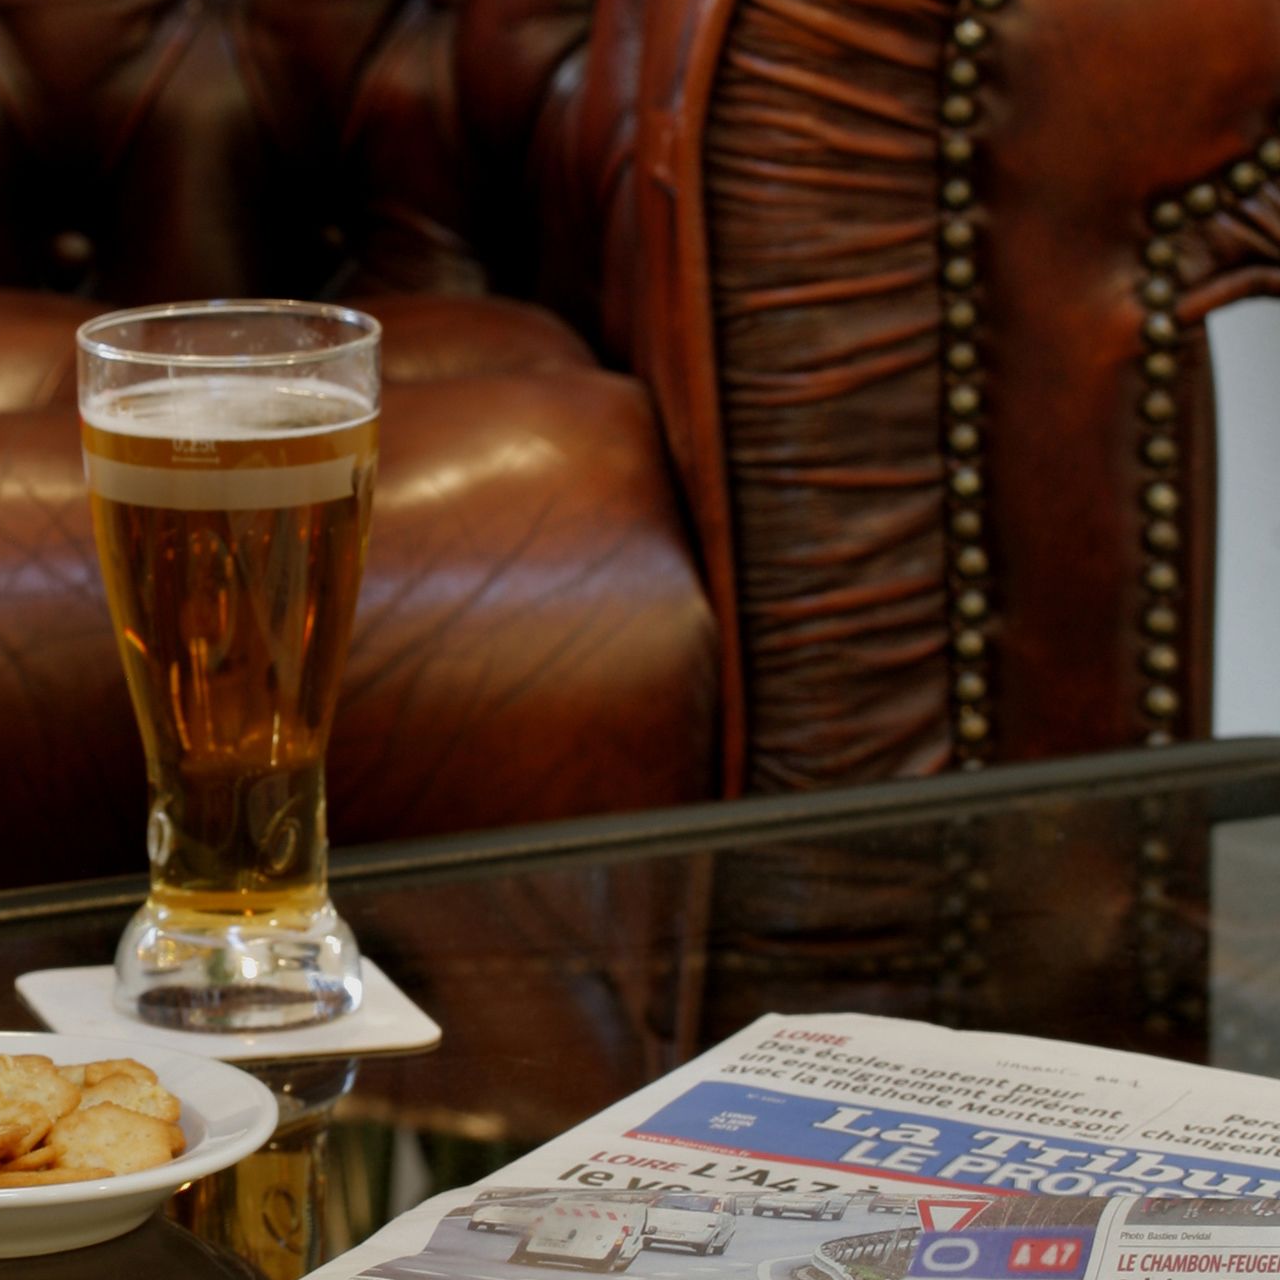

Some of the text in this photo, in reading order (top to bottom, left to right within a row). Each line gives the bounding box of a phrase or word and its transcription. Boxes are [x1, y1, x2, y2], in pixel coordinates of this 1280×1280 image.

[772, 1028, 852, 1047] LOIRE
[738, 1051, 776, 1064] un
[782, 1058, 987, 1100] enseignement
[990, 1089, 1123, 1120] différent
[757, 1040, 808, 1055] Des
[815, 1046, 907, 1071] écoles
[910, 1065, 1010, 1090] optent
[1008, 1082, 1086, 1102] pour
[720, 1063, 1130, 1135] avec la méthode Montessori
[813, 1106, 941, 1147] La
[557, 1162, 615, 1188] le
[588, 1150, 688, 1173] LOIRE
[838, 1139, 1245, 1200] LE PROG
[1120, 1231, 1212, 1241] Photo Bastien Devidal
[1117, 1253, 1280, 1273] LE CHAMBON-FEUGE
